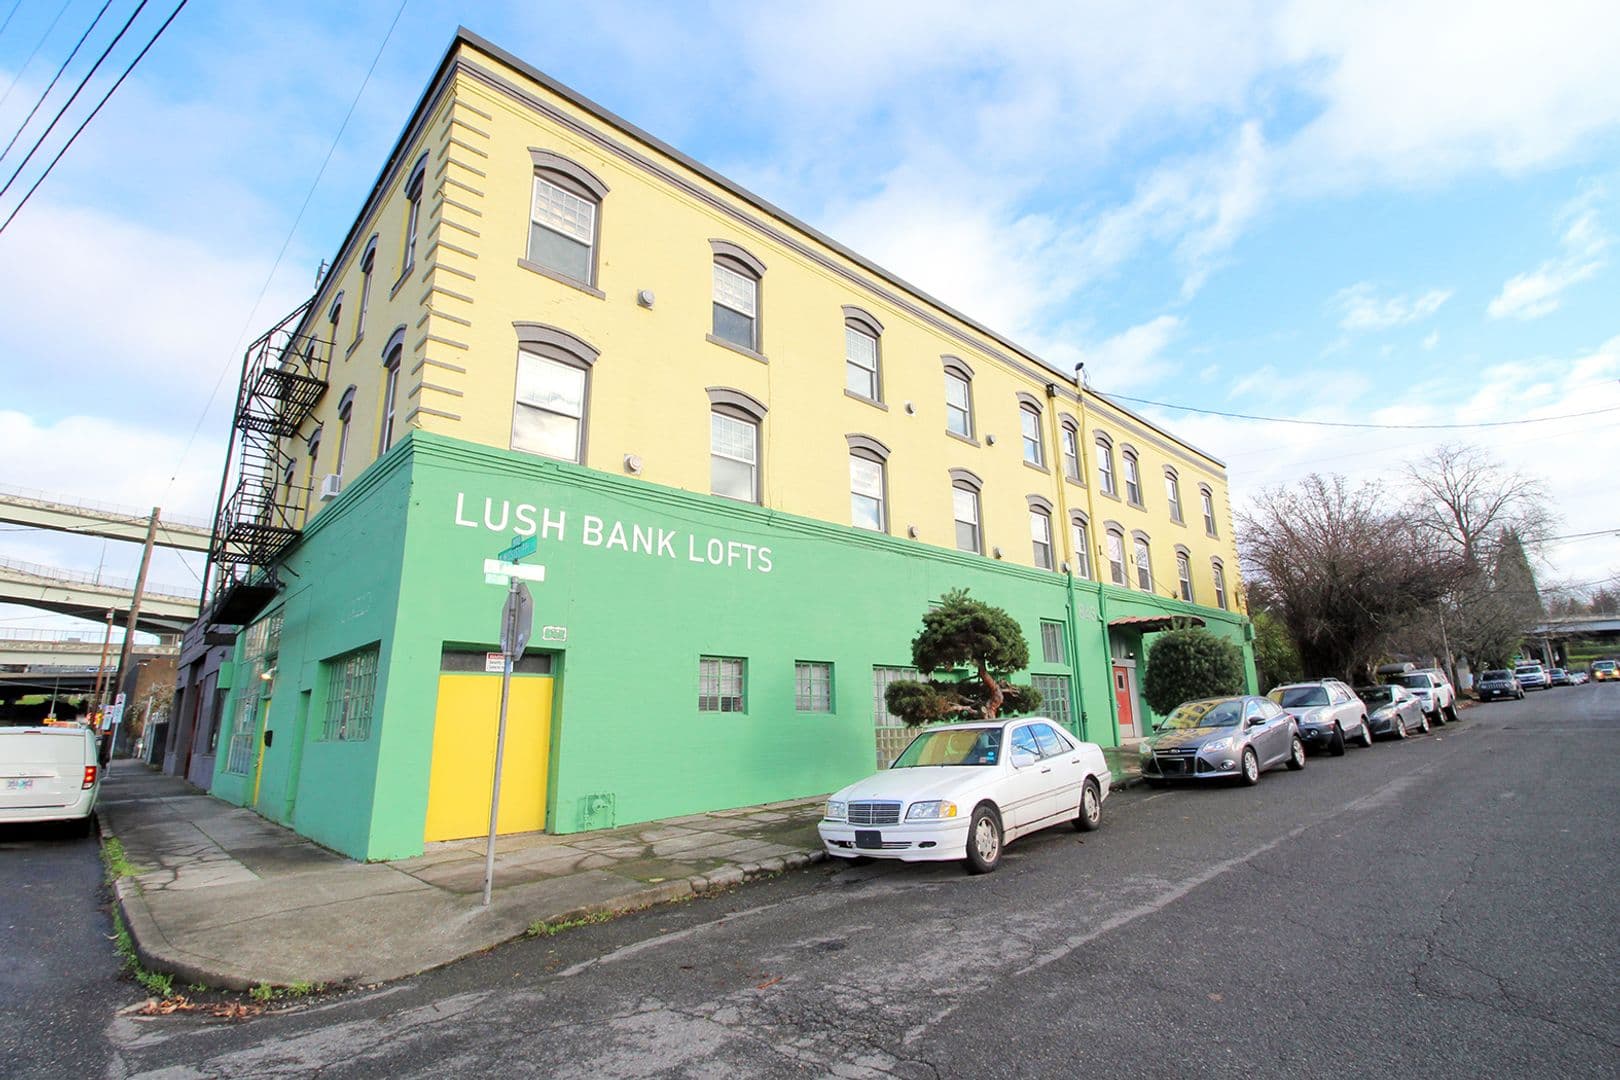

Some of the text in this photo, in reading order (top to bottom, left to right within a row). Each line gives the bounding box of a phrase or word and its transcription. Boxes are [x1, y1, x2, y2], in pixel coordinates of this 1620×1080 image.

[455, 492, 773, 573] LUSH BANK LOFTS
